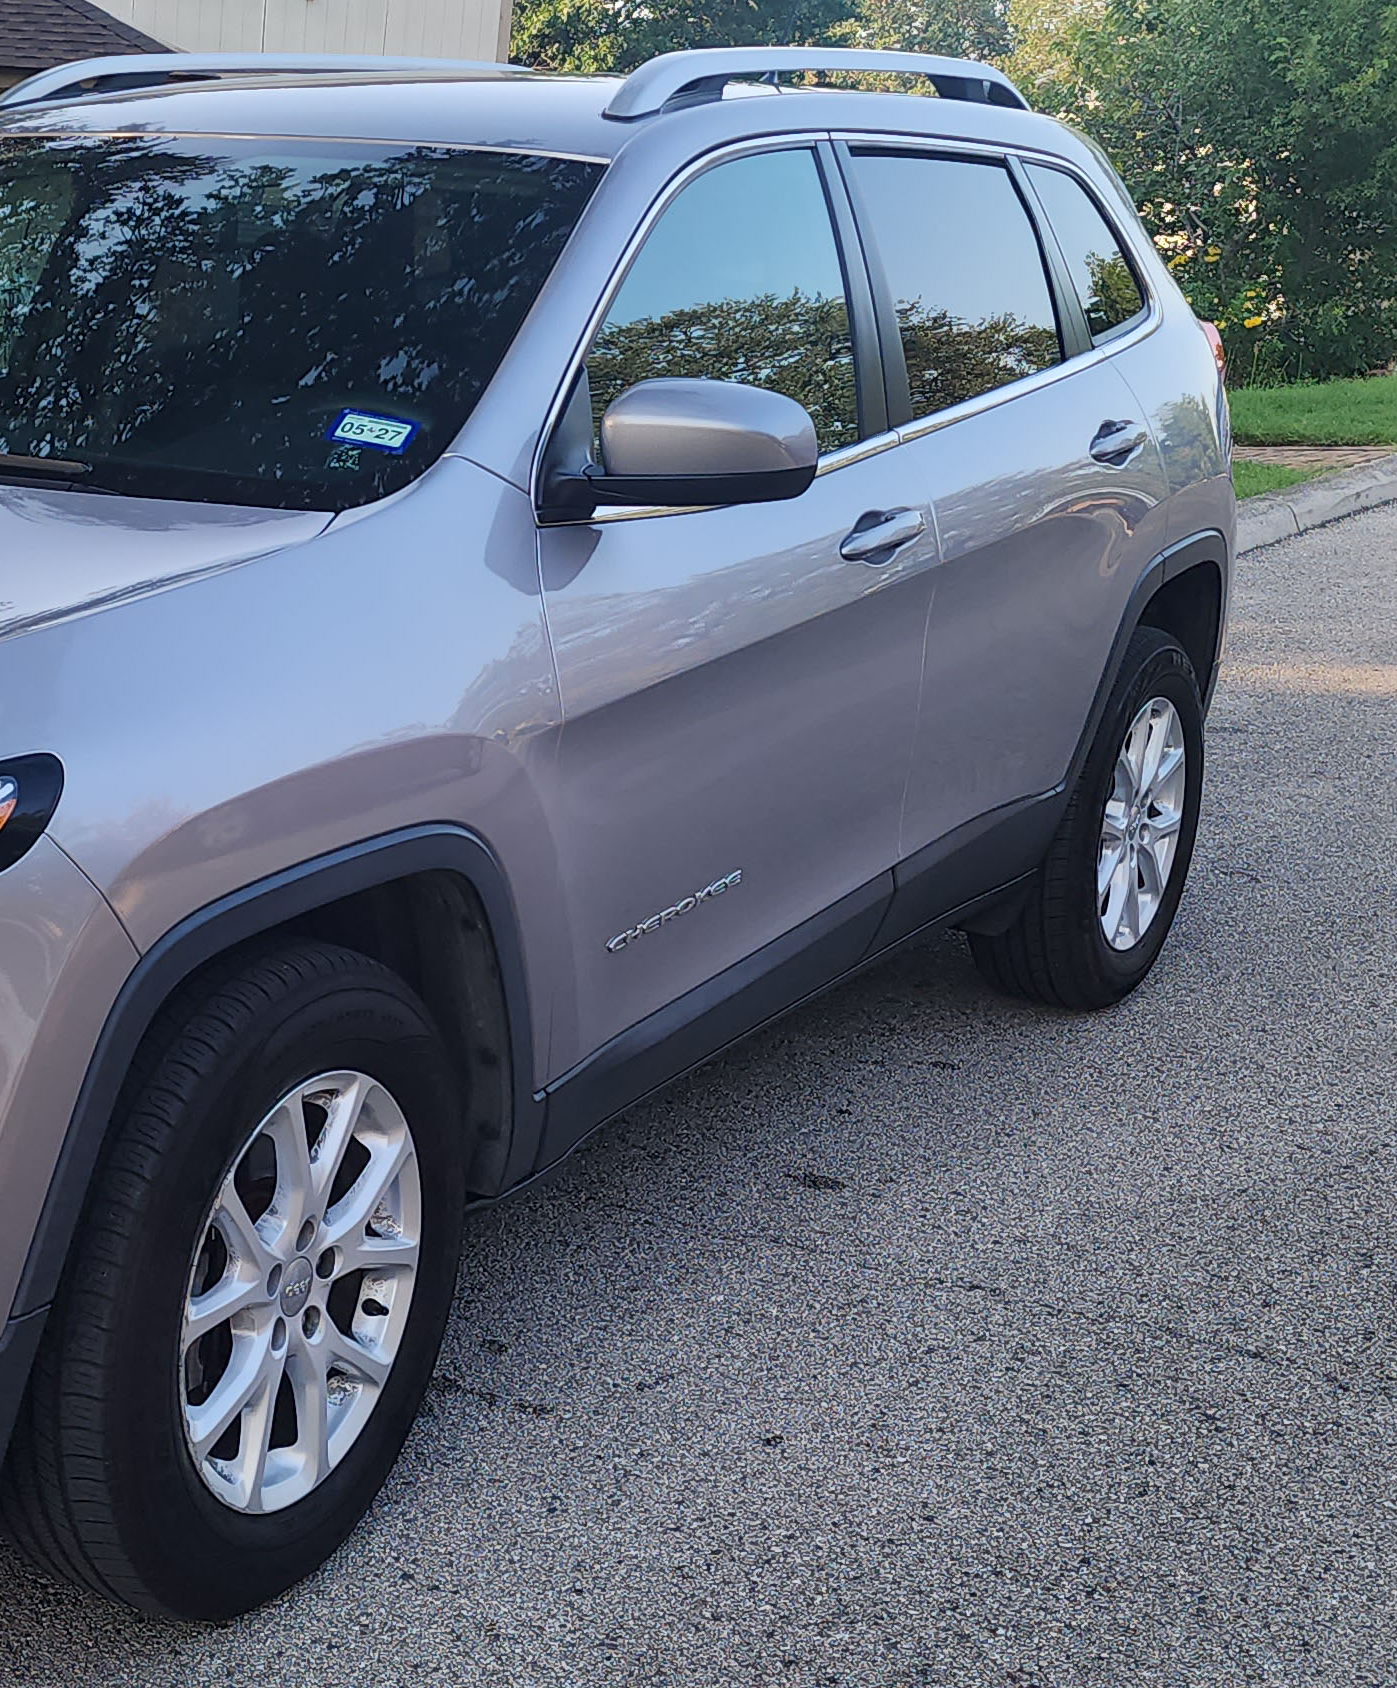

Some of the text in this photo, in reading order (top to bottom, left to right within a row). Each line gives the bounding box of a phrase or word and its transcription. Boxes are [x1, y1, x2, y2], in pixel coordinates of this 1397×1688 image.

[340, 421, 368, 436] 05
[373, 427, 404, 442] 27
[604, 867, 742, 952] CHEROKEE
